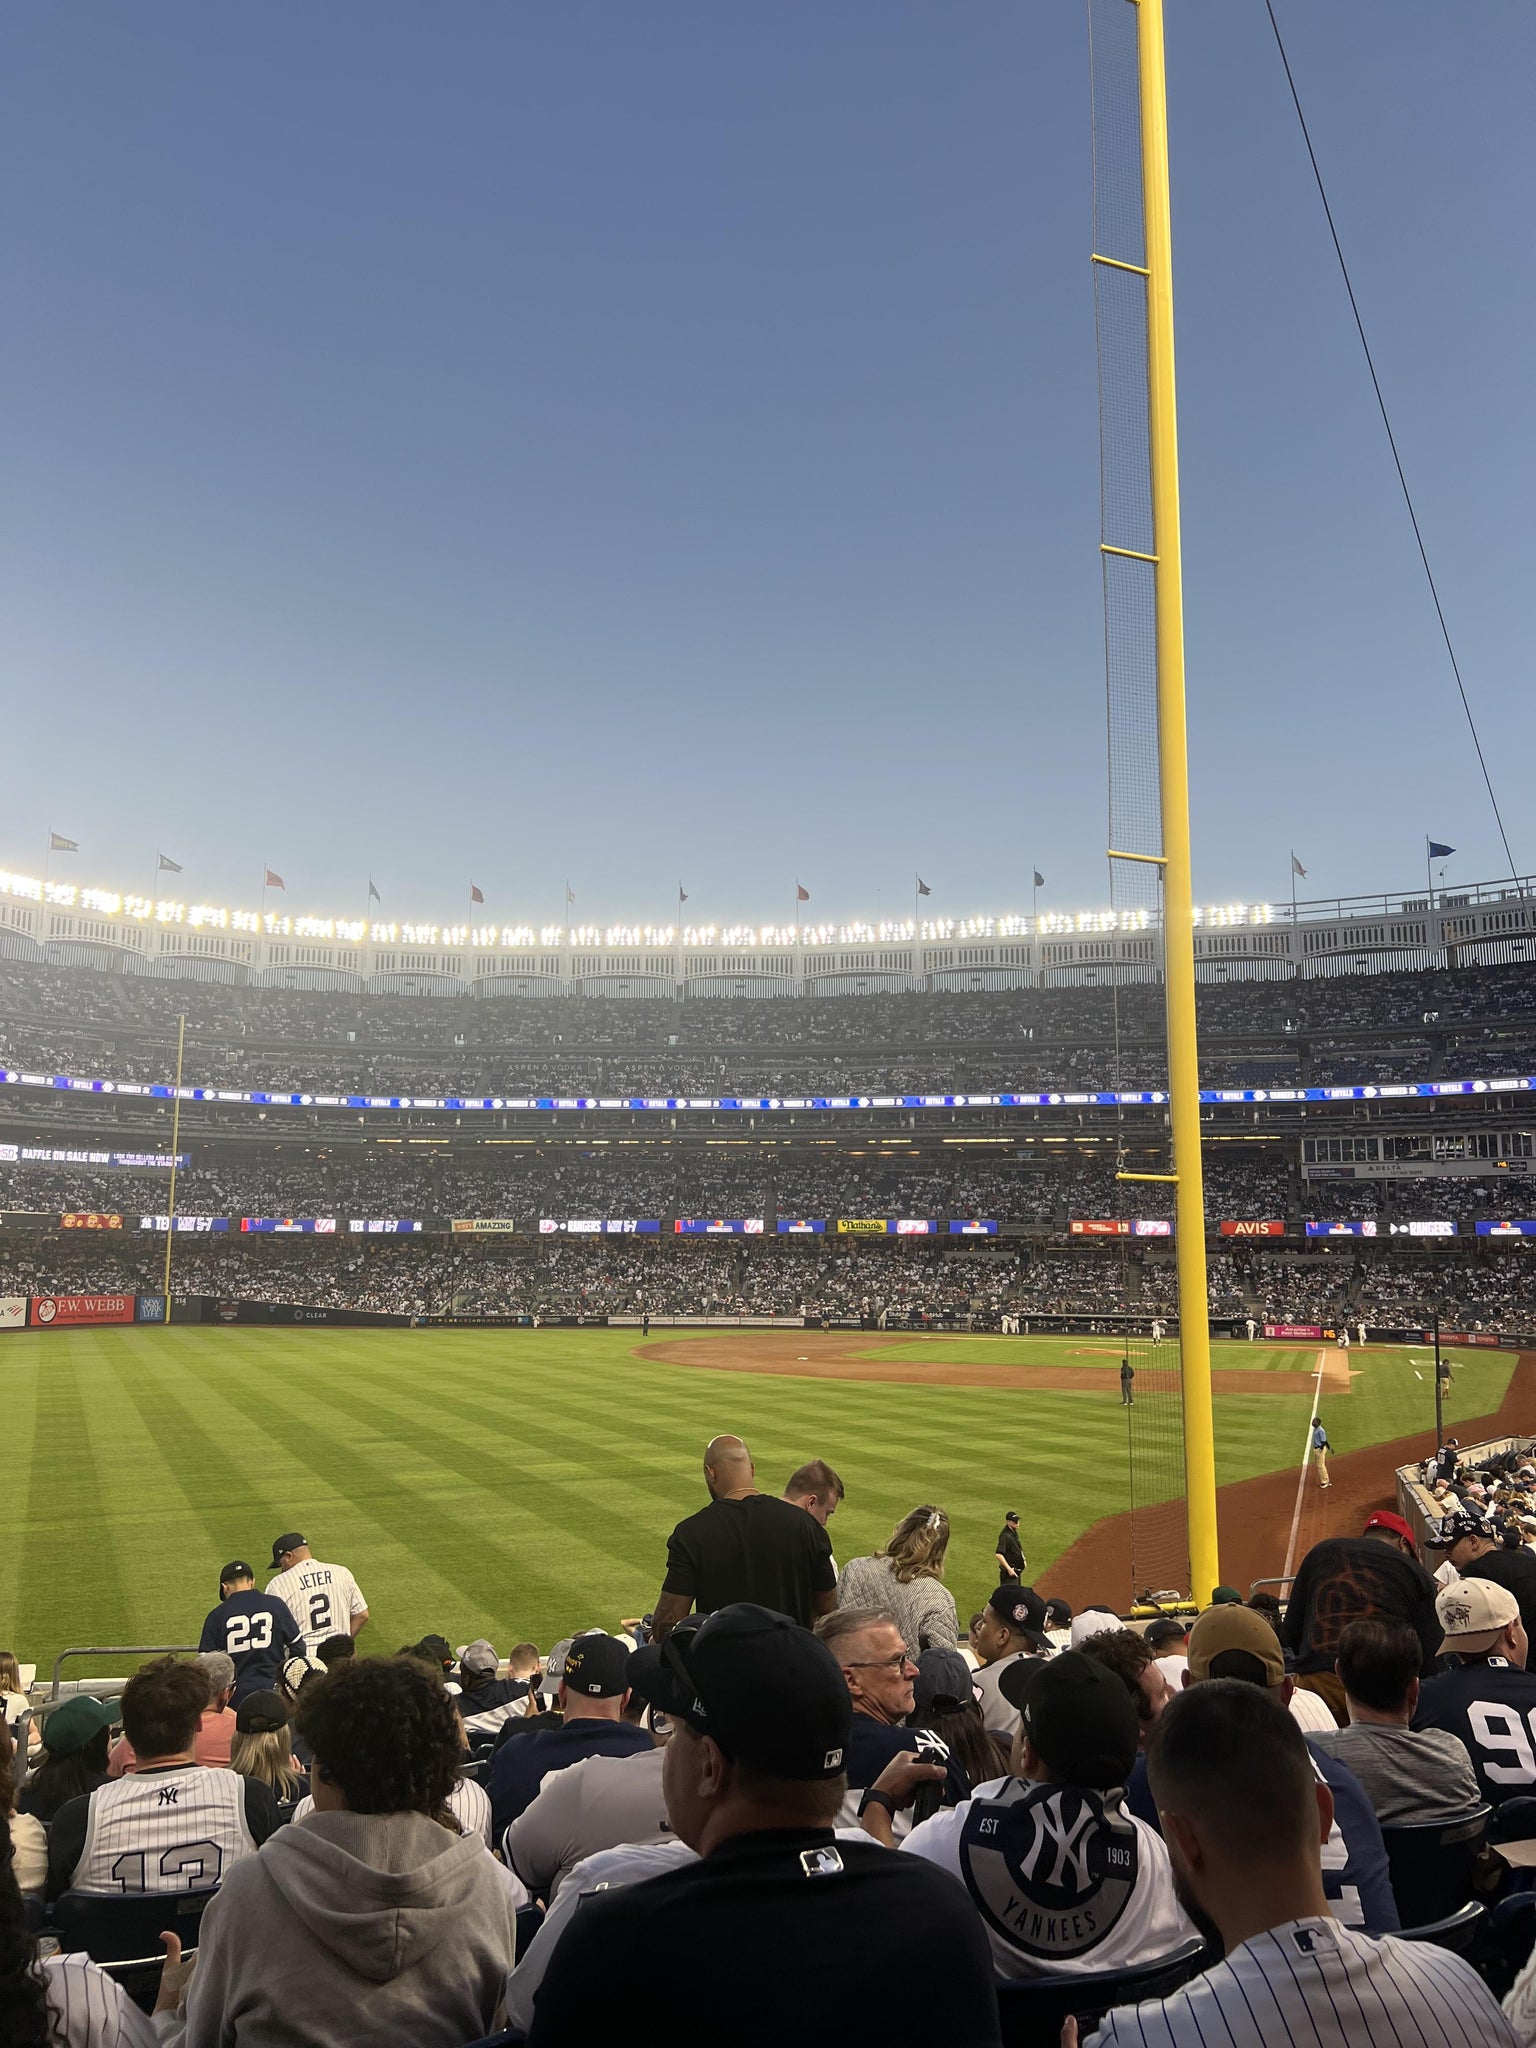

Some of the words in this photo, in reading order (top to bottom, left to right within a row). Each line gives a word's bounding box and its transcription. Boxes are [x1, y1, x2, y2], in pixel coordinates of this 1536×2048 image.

[21, 1148, 52, 1160] RAFFLE
[52, 1150, 66, 1161] ON
[66, 1151, 88, 1162] SALE
[89, 1152, 110, 1163] NOW
[155, 1217, 170, 1231] TE
[196, 1217, 213, 1231] 5-7
[349, 1220, 365, 1233] TEX
[385, 1220, 399, 1233] 5-7
[475, 1222, 511, 1230] AMAZING
[567, 1220, 602, 1233] RANGERS
[624, 1220, 638, 1233] 5-7
[842, 1220, 883, 1232] Nathan's
[1235, 1222, 1270, 1235] AVIS
[1409, 1221, 1454, 1235] RANGERS
[58, 1299, 81, 1312] F.W.
[84, 1299, 125, 1312] WEBB
[142, 1304, 162, 1312] YORK
[299, 1570, 332, 1591] JETER
[309, 1593, 332, 1631] 2
[226, 1611, 273, 1654] 23
[1467, 1700, 1536, 1785] 9
[158, 1787, 179, 1806] NY
[979, 1817, 1000, 1835] EST
[1020, 1791, 1100, 1894] NY
[1107, 1846, 1131, 1867] 1903
[1002, 1895, 1098, 1942] YANKEES
